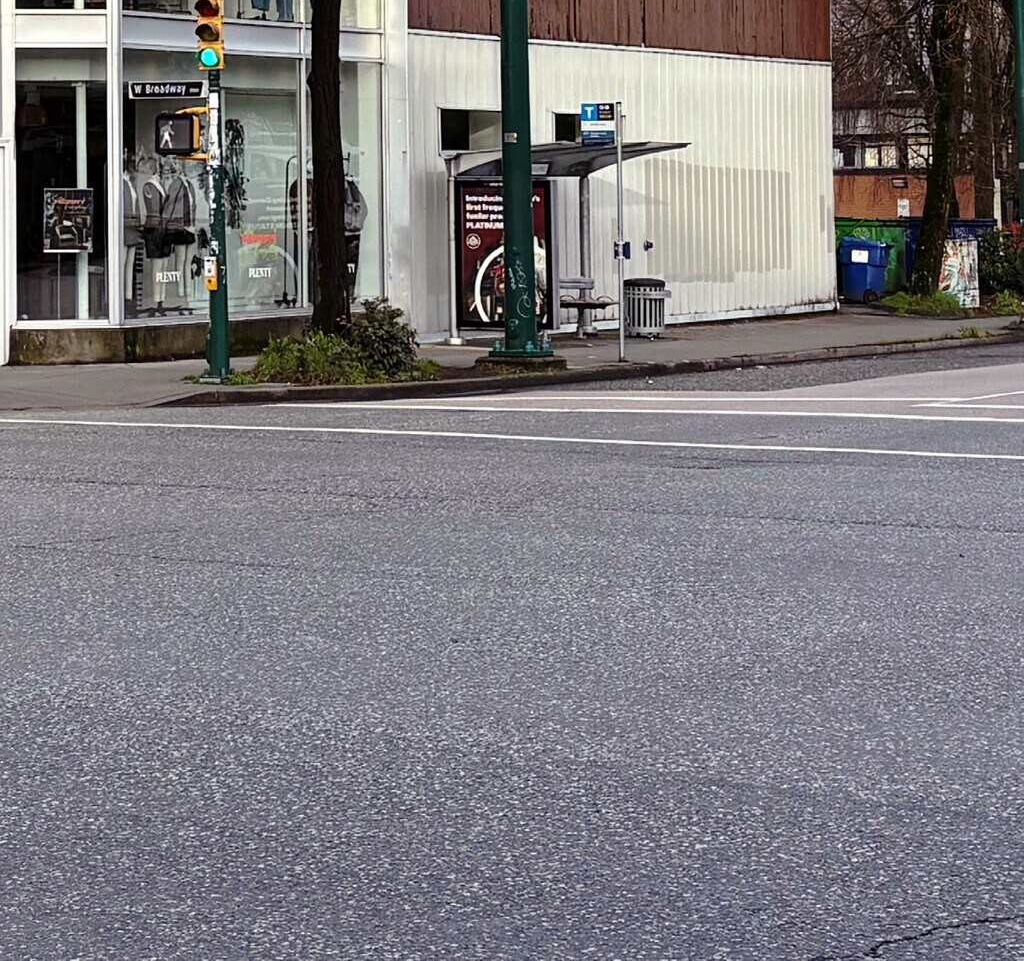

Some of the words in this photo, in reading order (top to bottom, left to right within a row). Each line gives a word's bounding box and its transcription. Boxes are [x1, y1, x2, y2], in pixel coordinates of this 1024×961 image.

[134, 84, 142, 94] W
[145, 84, 186, 96] Broadway
[155, 271, 182, 283] PLENTY
[248, 267, 272, 279] PLENTY
